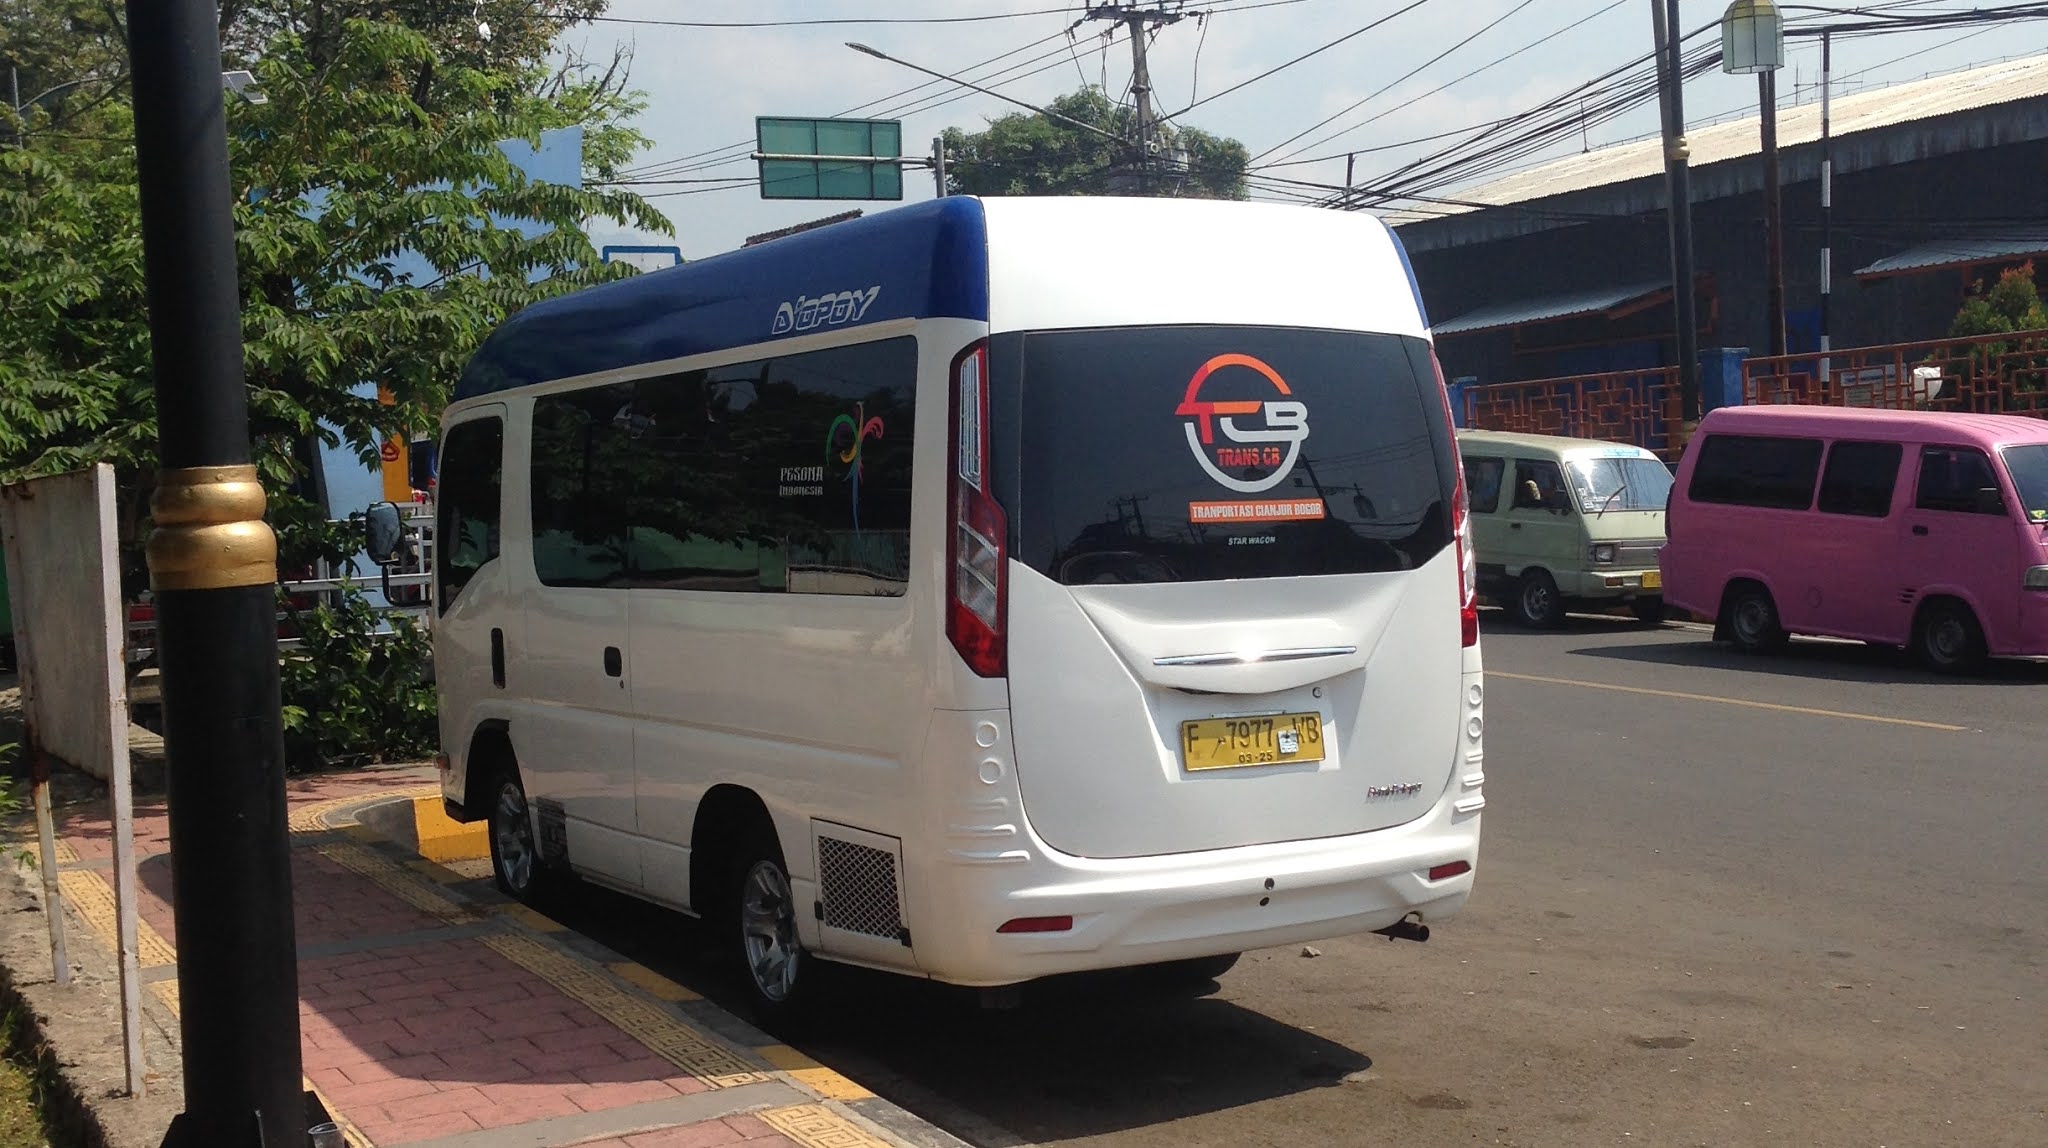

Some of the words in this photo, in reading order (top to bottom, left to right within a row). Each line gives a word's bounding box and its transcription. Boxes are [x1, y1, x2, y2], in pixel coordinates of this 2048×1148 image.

[1216, 448, 1259, 467] TRANS
[1262, 446, 1280, 466] CB
[780, 466, 823, 481] PESONA
[779, 485, 823, 496] INDONESIA
[1192, 504, 1254, 519] TRANPORTASI
[1255, 503, 1293, 517] CIANJUR
[1294, 502, 1322, 515] BOGOR
[1228, 537, 1248, 546] STAR
[1248, 536, 1276, 545] WAGON
[1187, 724, 1199, 753] F
[1226, 719, 1274, 749] 7977
